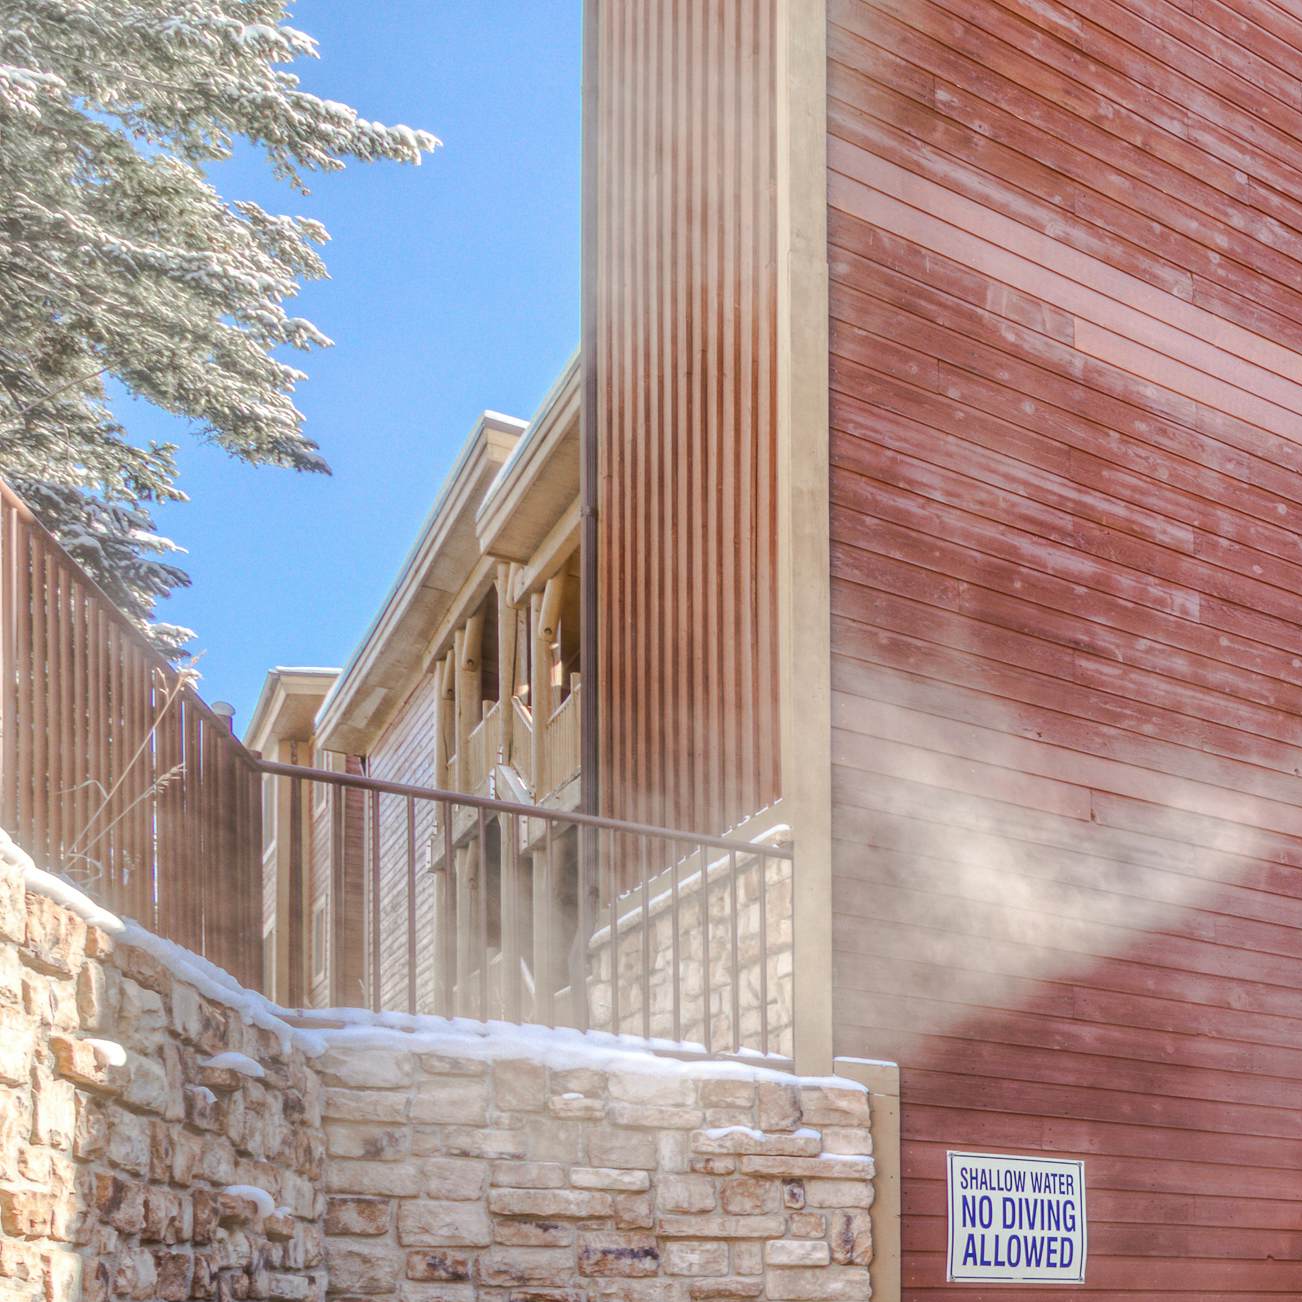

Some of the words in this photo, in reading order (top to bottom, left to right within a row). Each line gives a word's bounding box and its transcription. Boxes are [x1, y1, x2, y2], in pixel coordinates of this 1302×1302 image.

[960, 1167, 1026, 1192] SHALLOW
[1030, 1171, 1074, 1196] WATER
[961, 1195, 993, 1229] NO
[1002, 1197, 1076, 1232] DIVING
[962, 1233, 1074, 1268] ALLOWED
